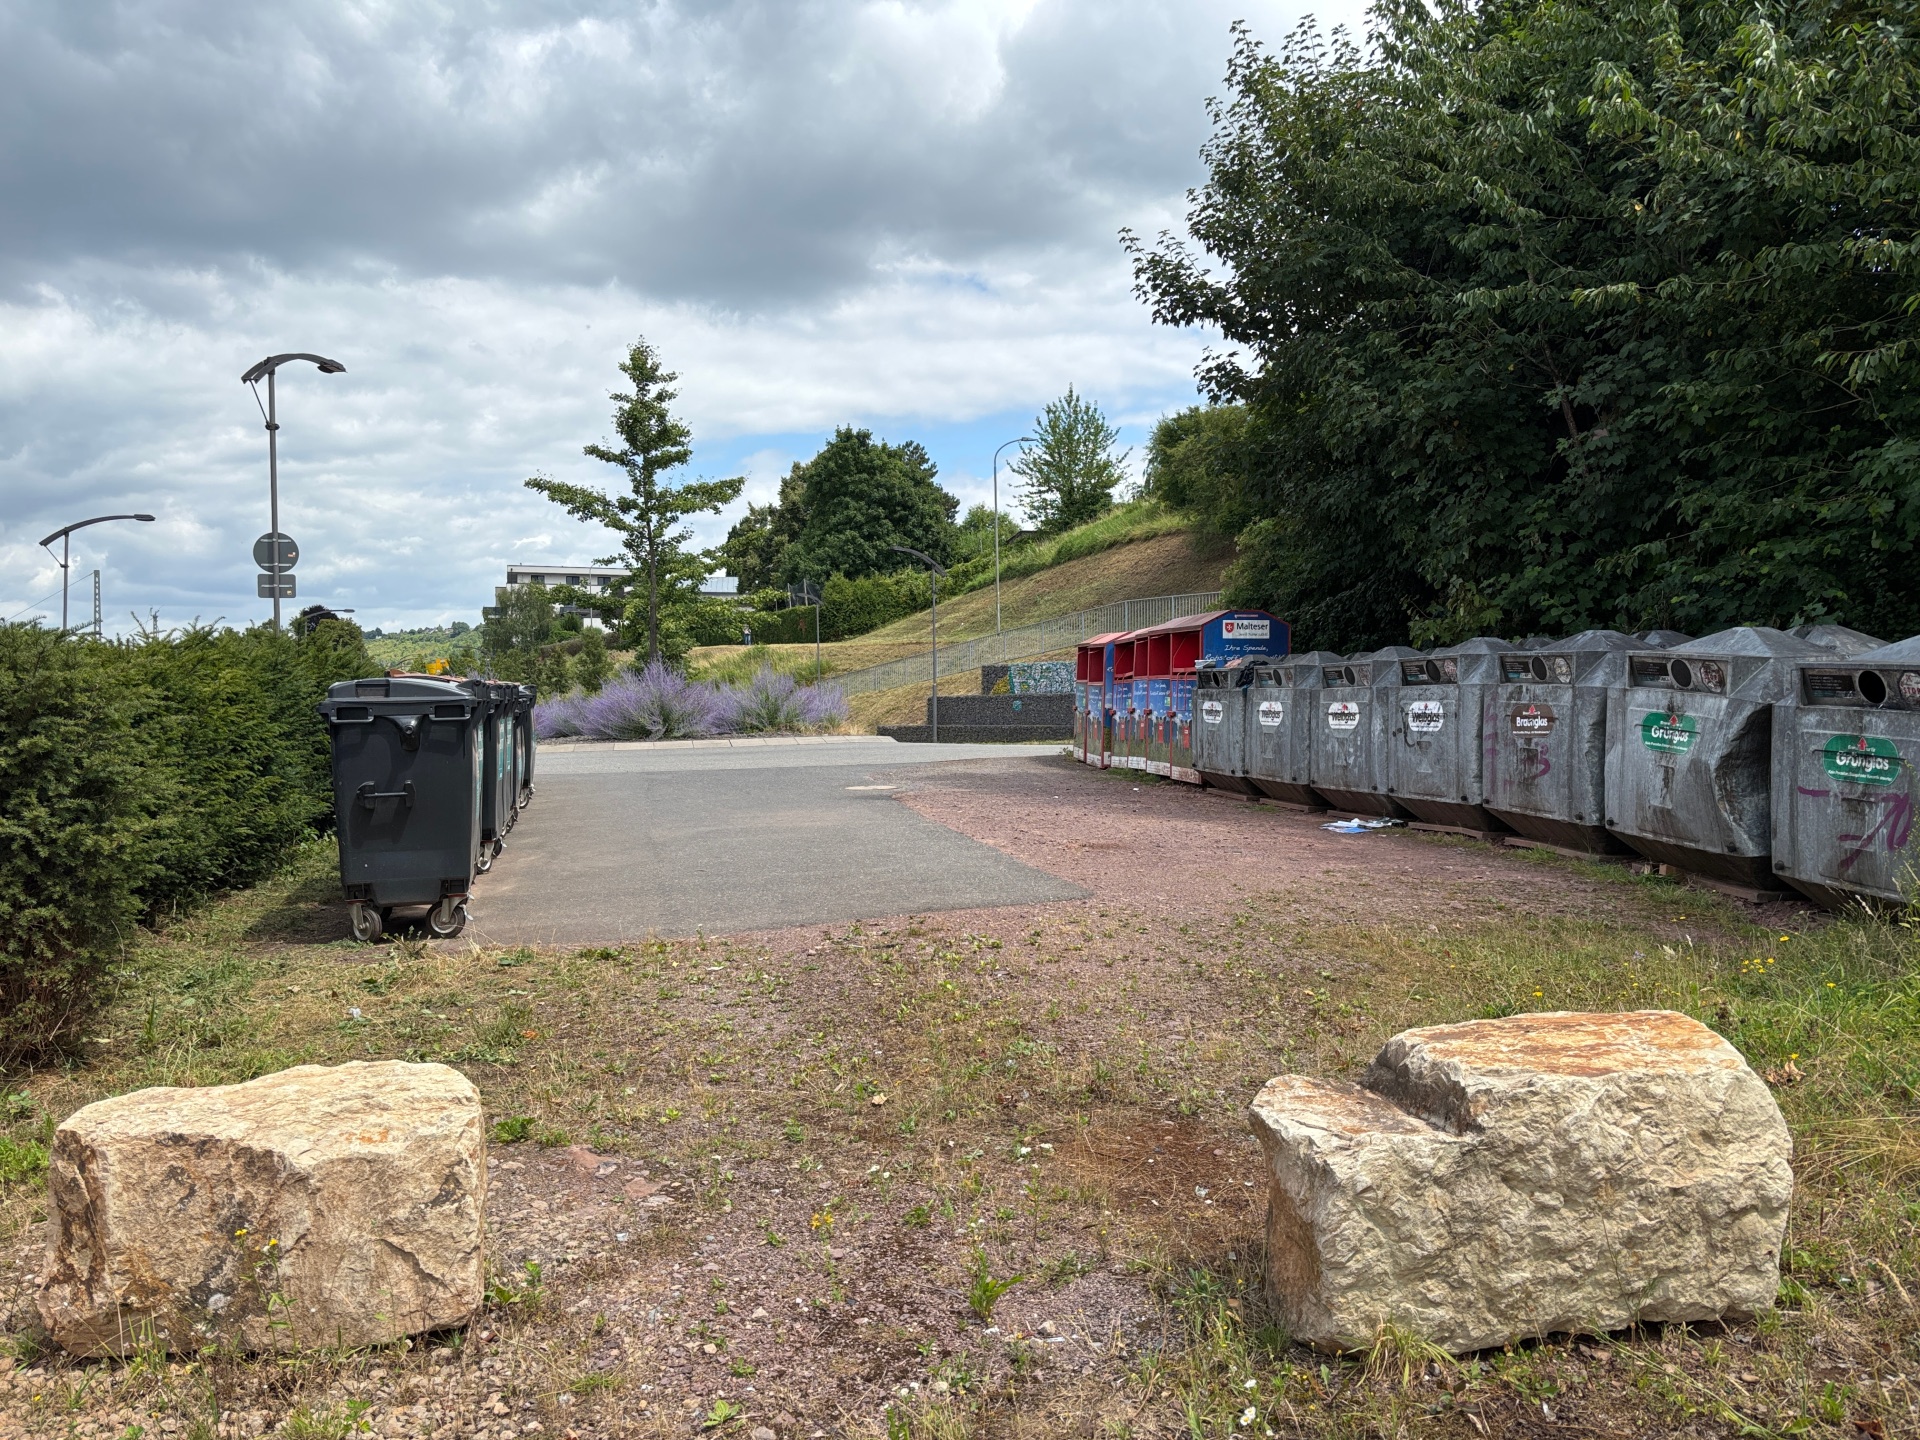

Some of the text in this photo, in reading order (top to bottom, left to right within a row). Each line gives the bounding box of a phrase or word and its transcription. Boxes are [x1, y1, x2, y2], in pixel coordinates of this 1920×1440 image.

[1236, 622, 1268, 631] Malteser
[1516, 716, 1548, 729] Braunglas
[1651, 725, 1690, 744] Grünglas
[1836, 751, 1889, 772] Grünglas
